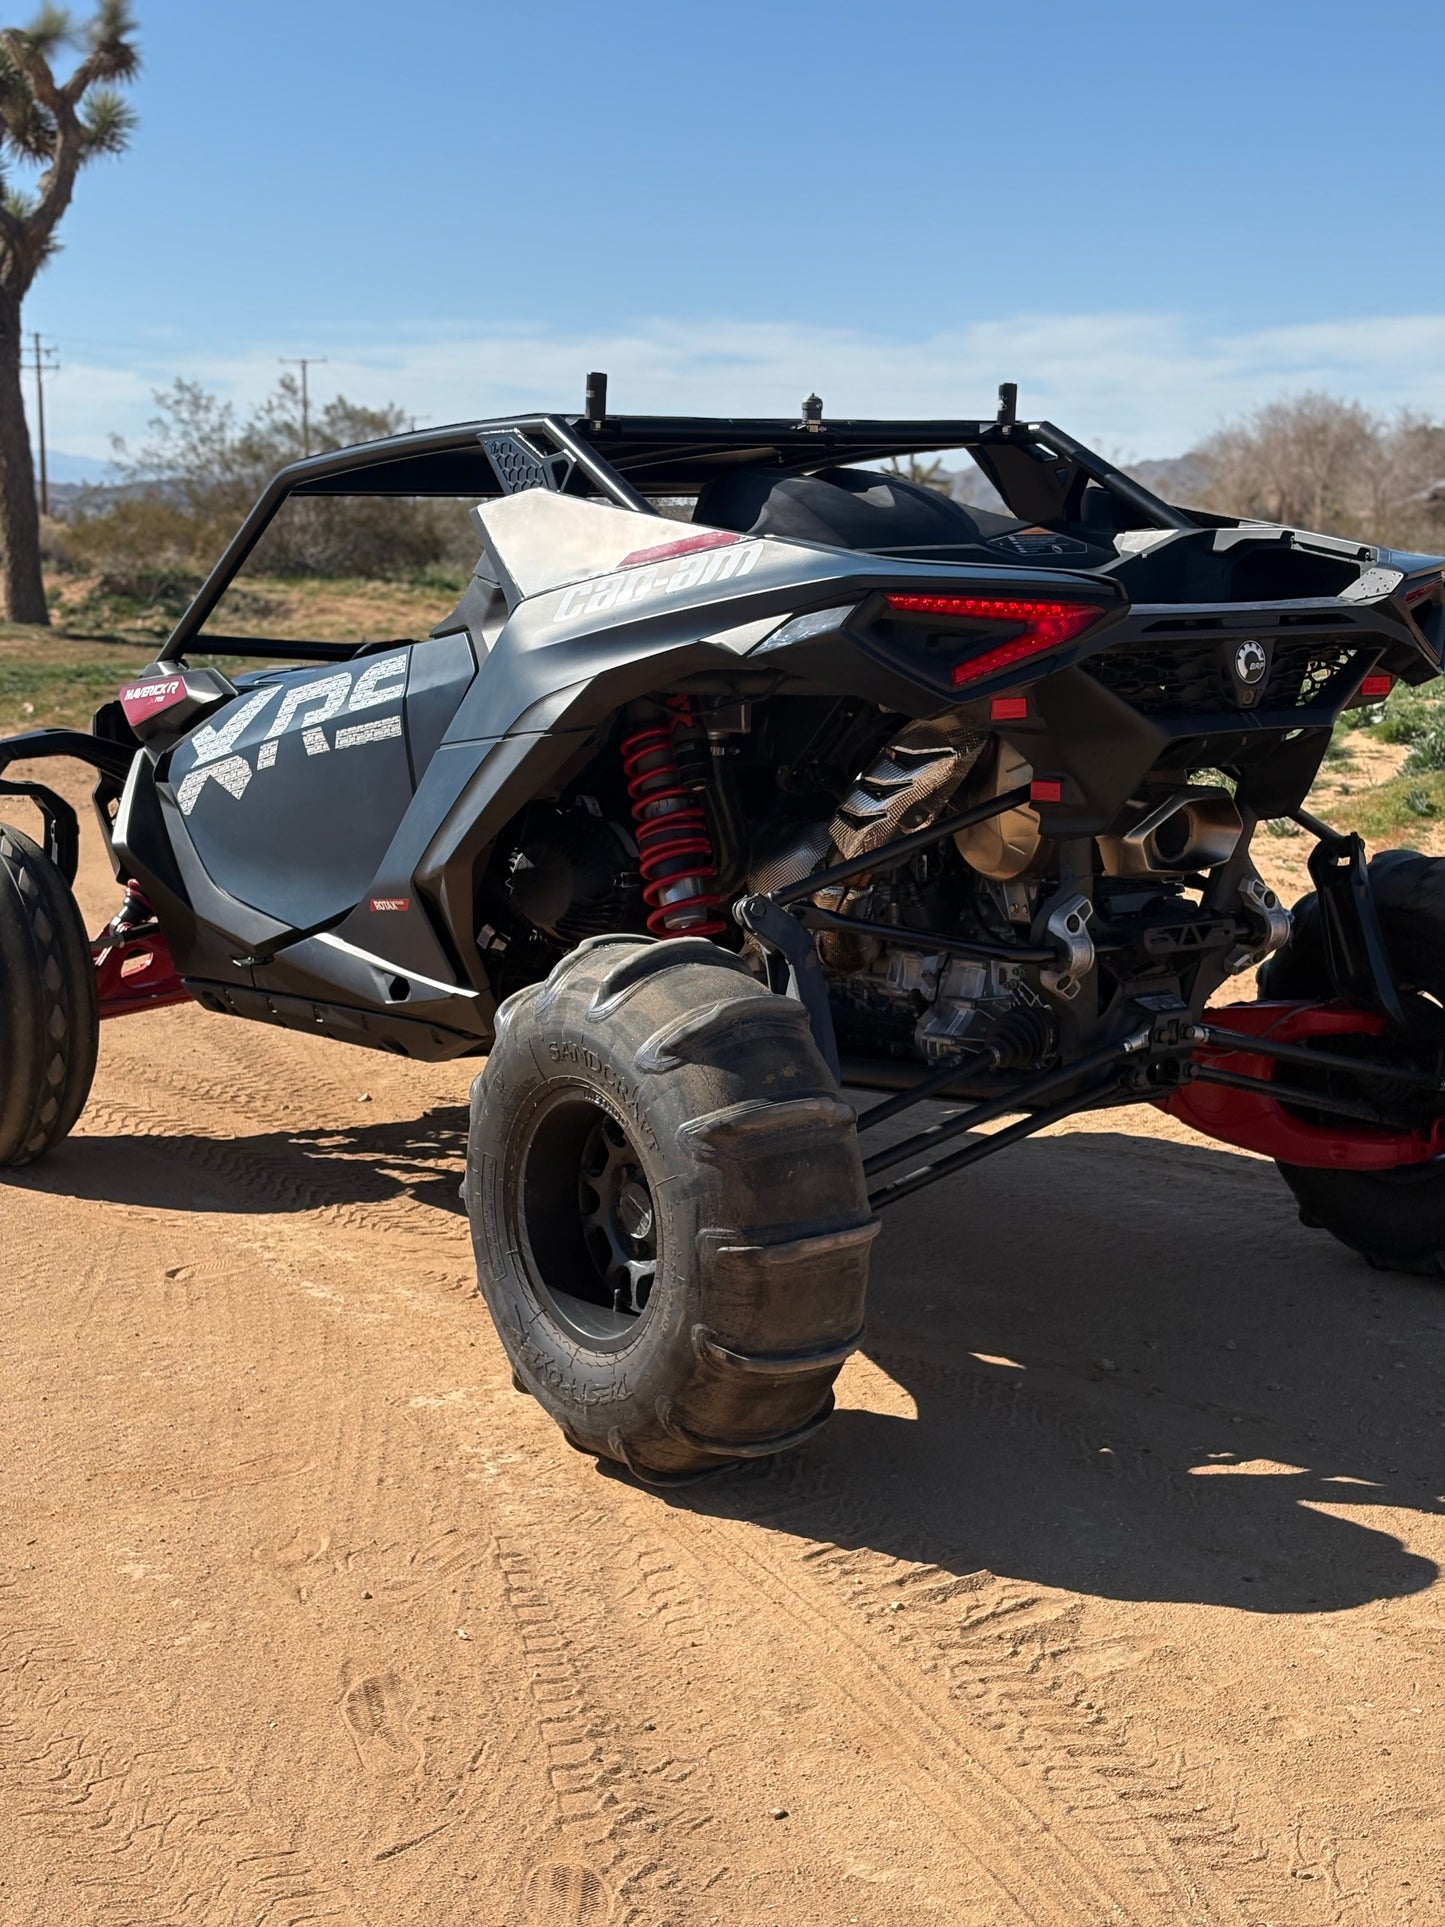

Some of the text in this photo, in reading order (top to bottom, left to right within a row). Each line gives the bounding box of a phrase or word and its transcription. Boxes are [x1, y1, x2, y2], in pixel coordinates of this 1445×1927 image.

[553, 542, 765, 623] can-am
[1250, 662, 1264, 670] BRP
[124, 683, 169, 701] MAVERICK
[373, 900, 398, 910] ROTAX
[549, 1038, 660, 1151] SANDCRAFT
